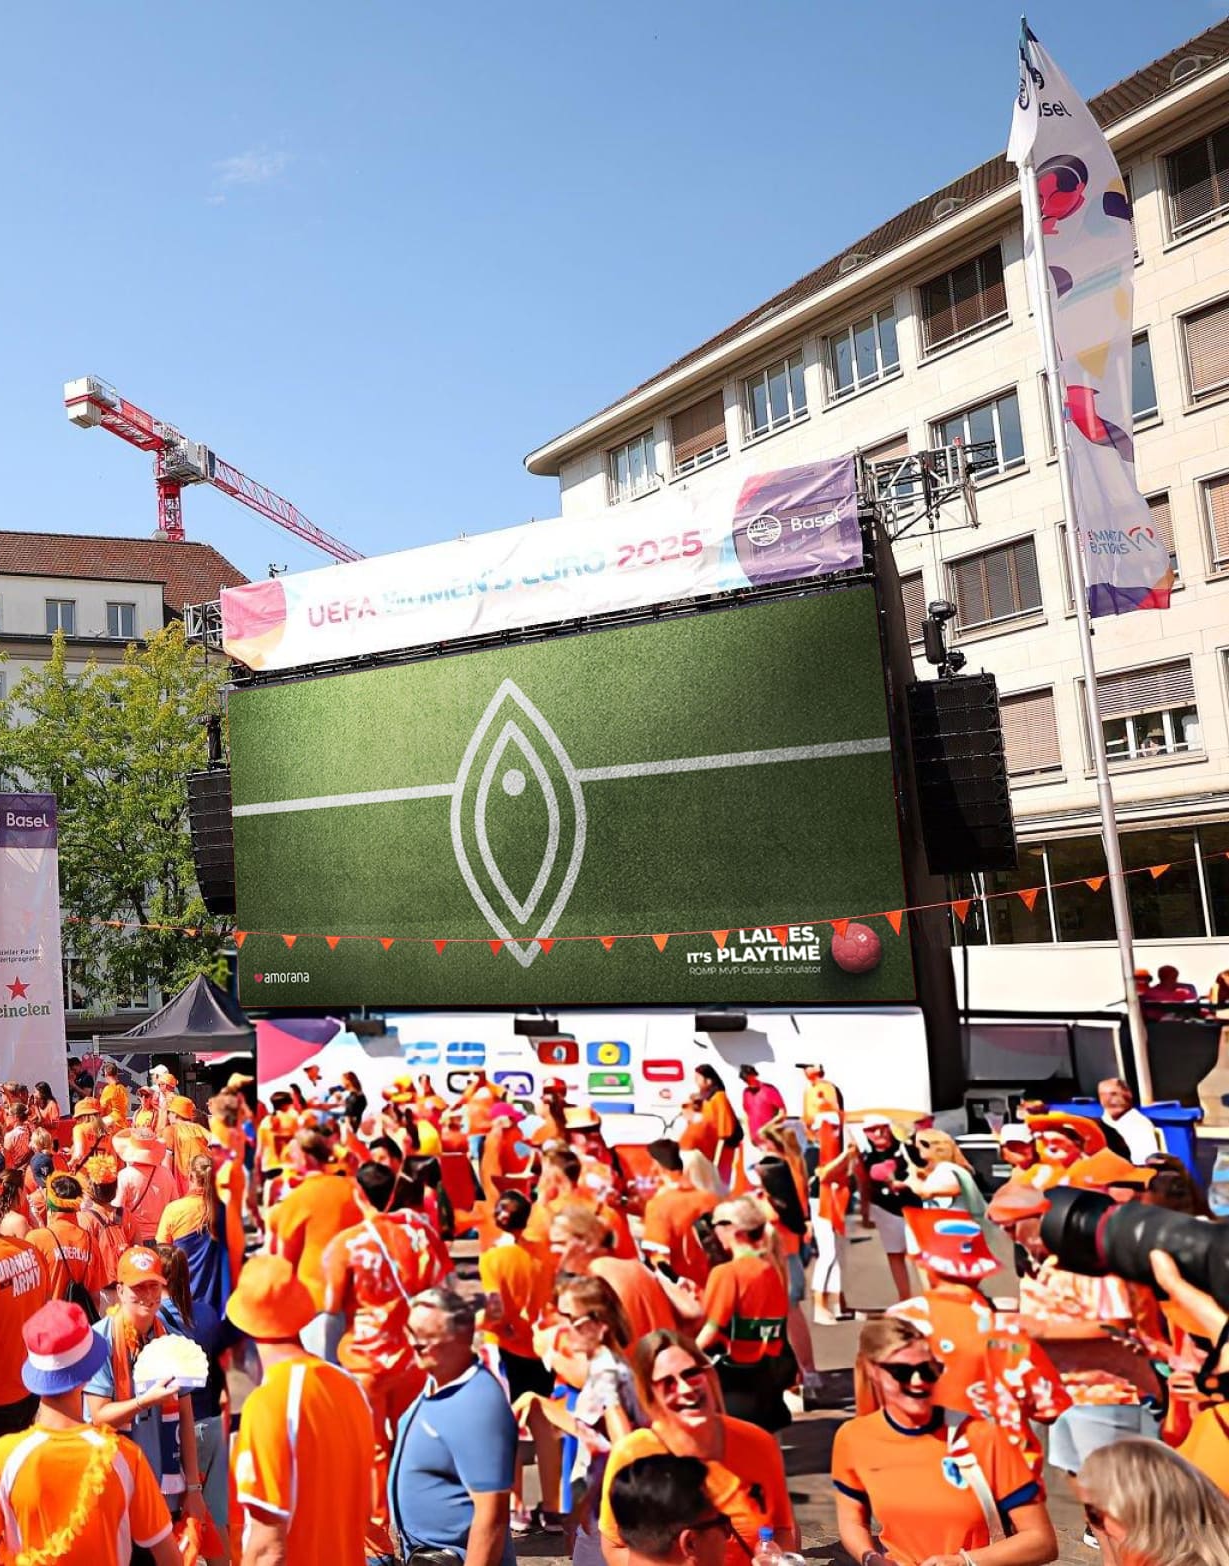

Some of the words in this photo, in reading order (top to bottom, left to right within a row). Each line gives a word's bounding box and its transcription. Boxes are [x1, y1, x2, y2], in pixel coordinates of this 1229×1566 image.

[1038, 100, 1072, 117] sel
[790, 509, 841, 532] Basel
[308, 597, 376, 627] UEFA
[616, 530, 703, 568] 2025
[6, 812, 50, 828] Basel
[739, 926, 820, 945] LAES,
[687, 952, 712, 963] IT'S
[717, 945, 821, 963] PLAYTIME
[264, 972, 310, 983] amorana
[13, 1266, 40, 1297] ARMY
